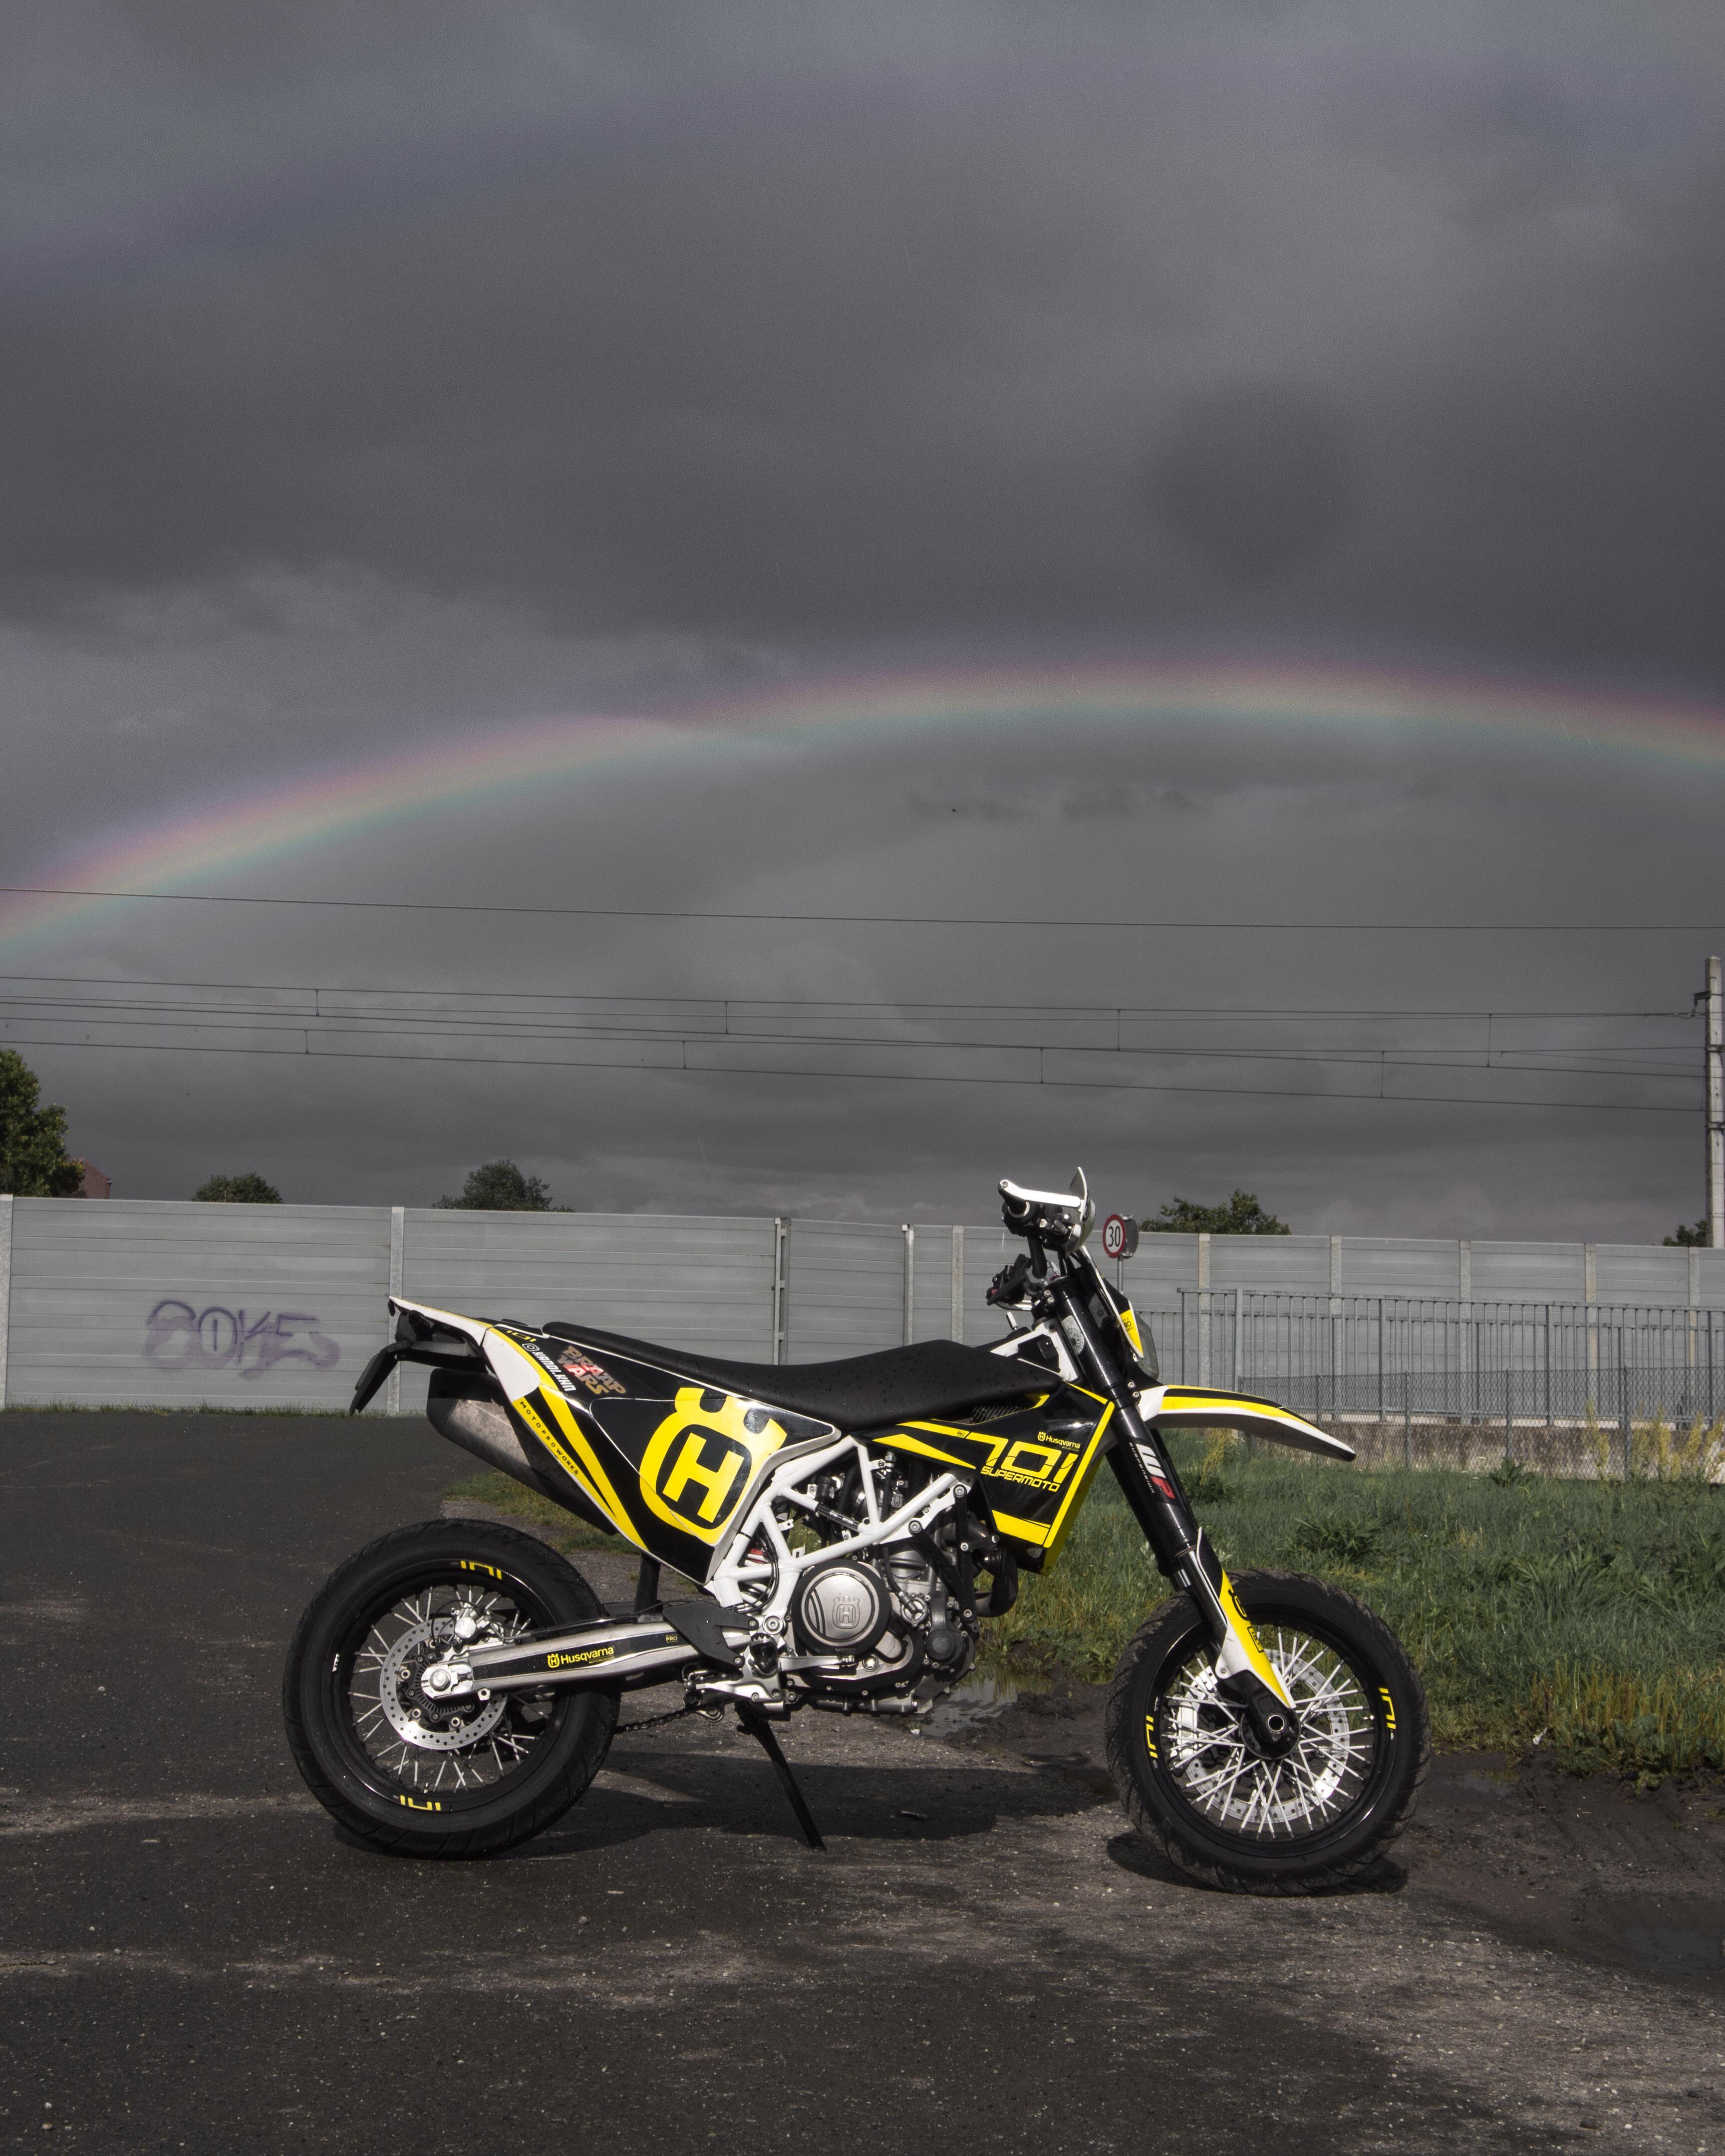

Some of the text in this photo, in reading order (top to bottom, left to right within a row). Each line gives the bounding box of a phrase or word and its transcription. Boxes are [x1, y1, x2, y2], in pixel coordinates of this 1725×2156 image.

[1109, 1226, 1121, 1247] 30
[557, 1354, 609, 1394] WARS
[562, 1346, 626, 1394] BRAAP
[966, 1432, 1078, 1484] 701
[1046, 1436, 1081, 1448] Husqvarna
[980, 1466, 1061, 1492] SUPERMOTO
[1129, 1442, 1154, 1493] SUSPENSION
[561, 1646, 614, 1664] Husqvarna
